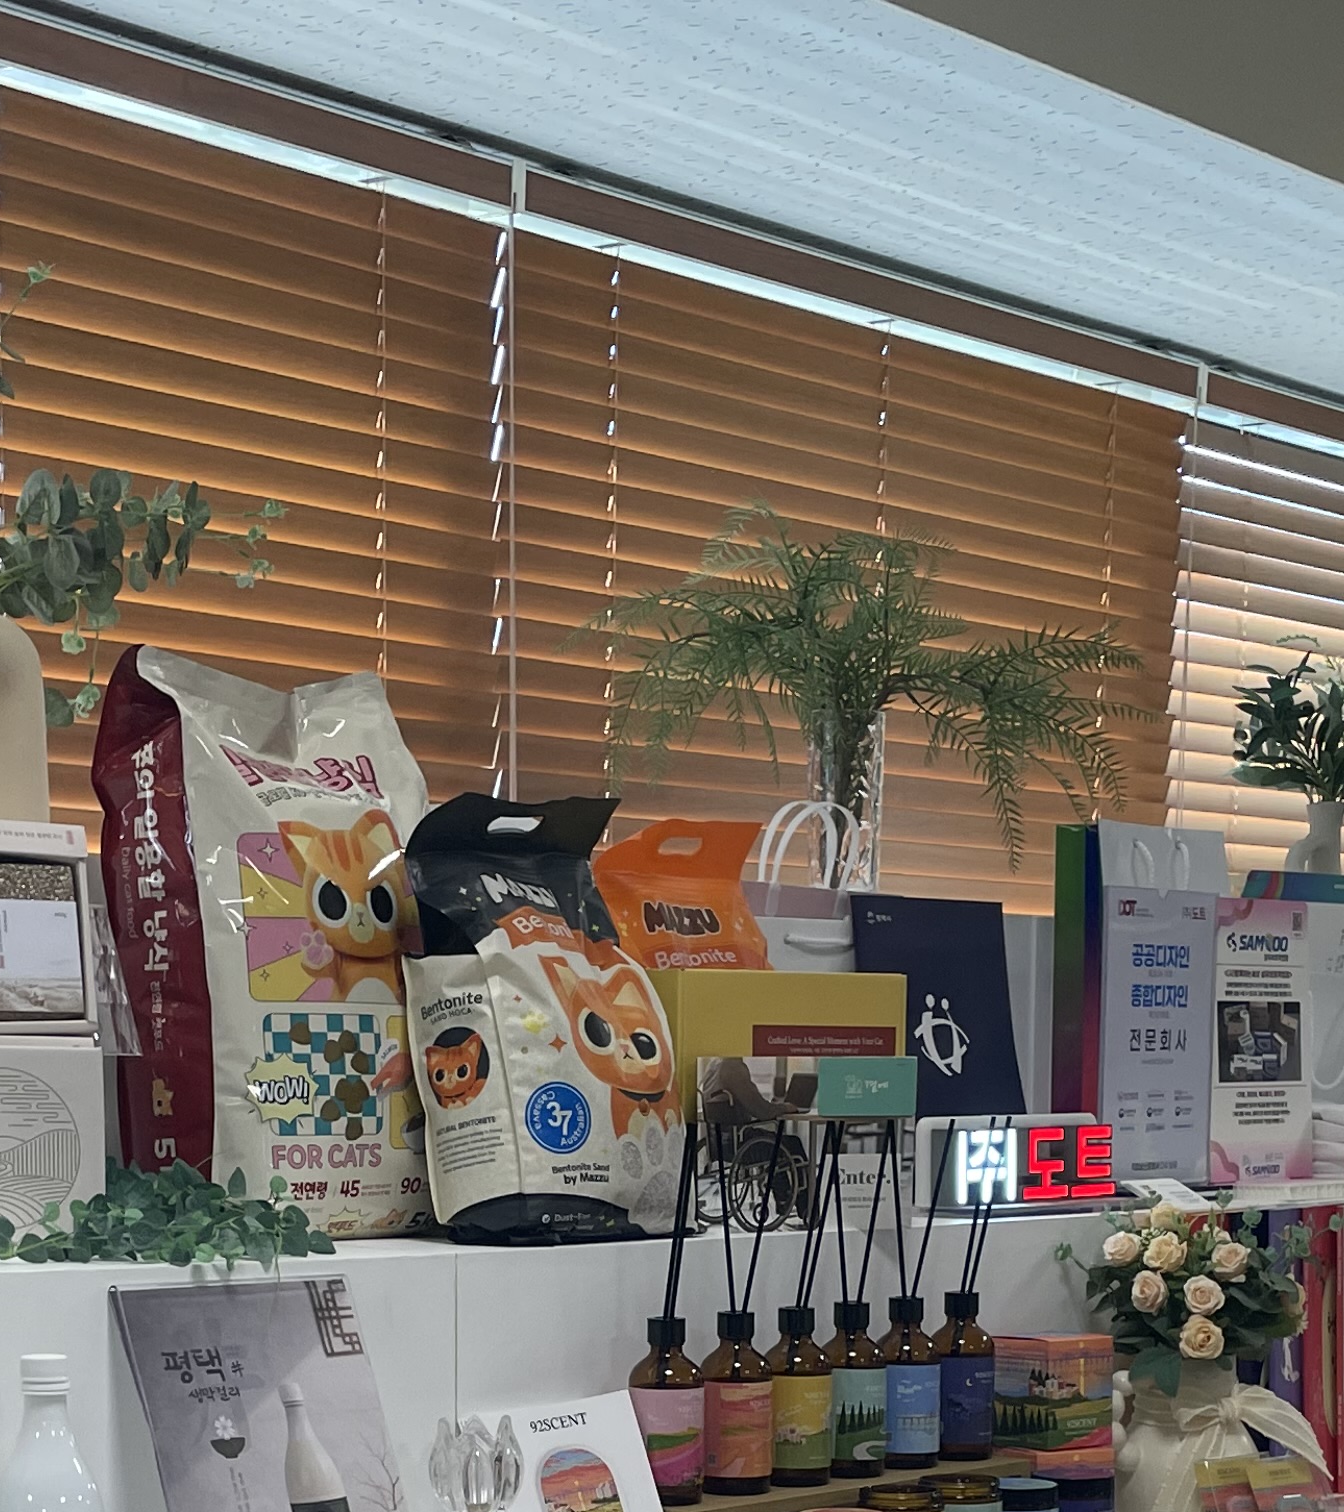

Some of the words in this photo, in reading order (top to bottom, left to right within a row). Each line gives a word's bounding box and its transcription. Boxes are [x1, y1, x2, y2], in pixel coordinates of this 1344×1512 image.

[120, 846, 132, 880] Daily
[643, 901, 721, 937] MAZZU
[1132, 943, 1191, 968] 공공디자인
[421, 991, 483, 1021] Bentonite
[1131, 984, 1189, 1008] 종합디자인
[253, 1075, 310, 1105] WOW!
[547, 1101, 572, 1135] 37
[271, 1144, 323, 1169] FOR
[328, 1143, 382, 1169] CATS
[340, 1180, 361, 1198] 45
[401, 1177, 421, 1195] 90
[563, 1175, 577, 1185] by
[161, 1346, 227, 1384] 평택
[530, 1412, 588, 1434] 92SCENT
